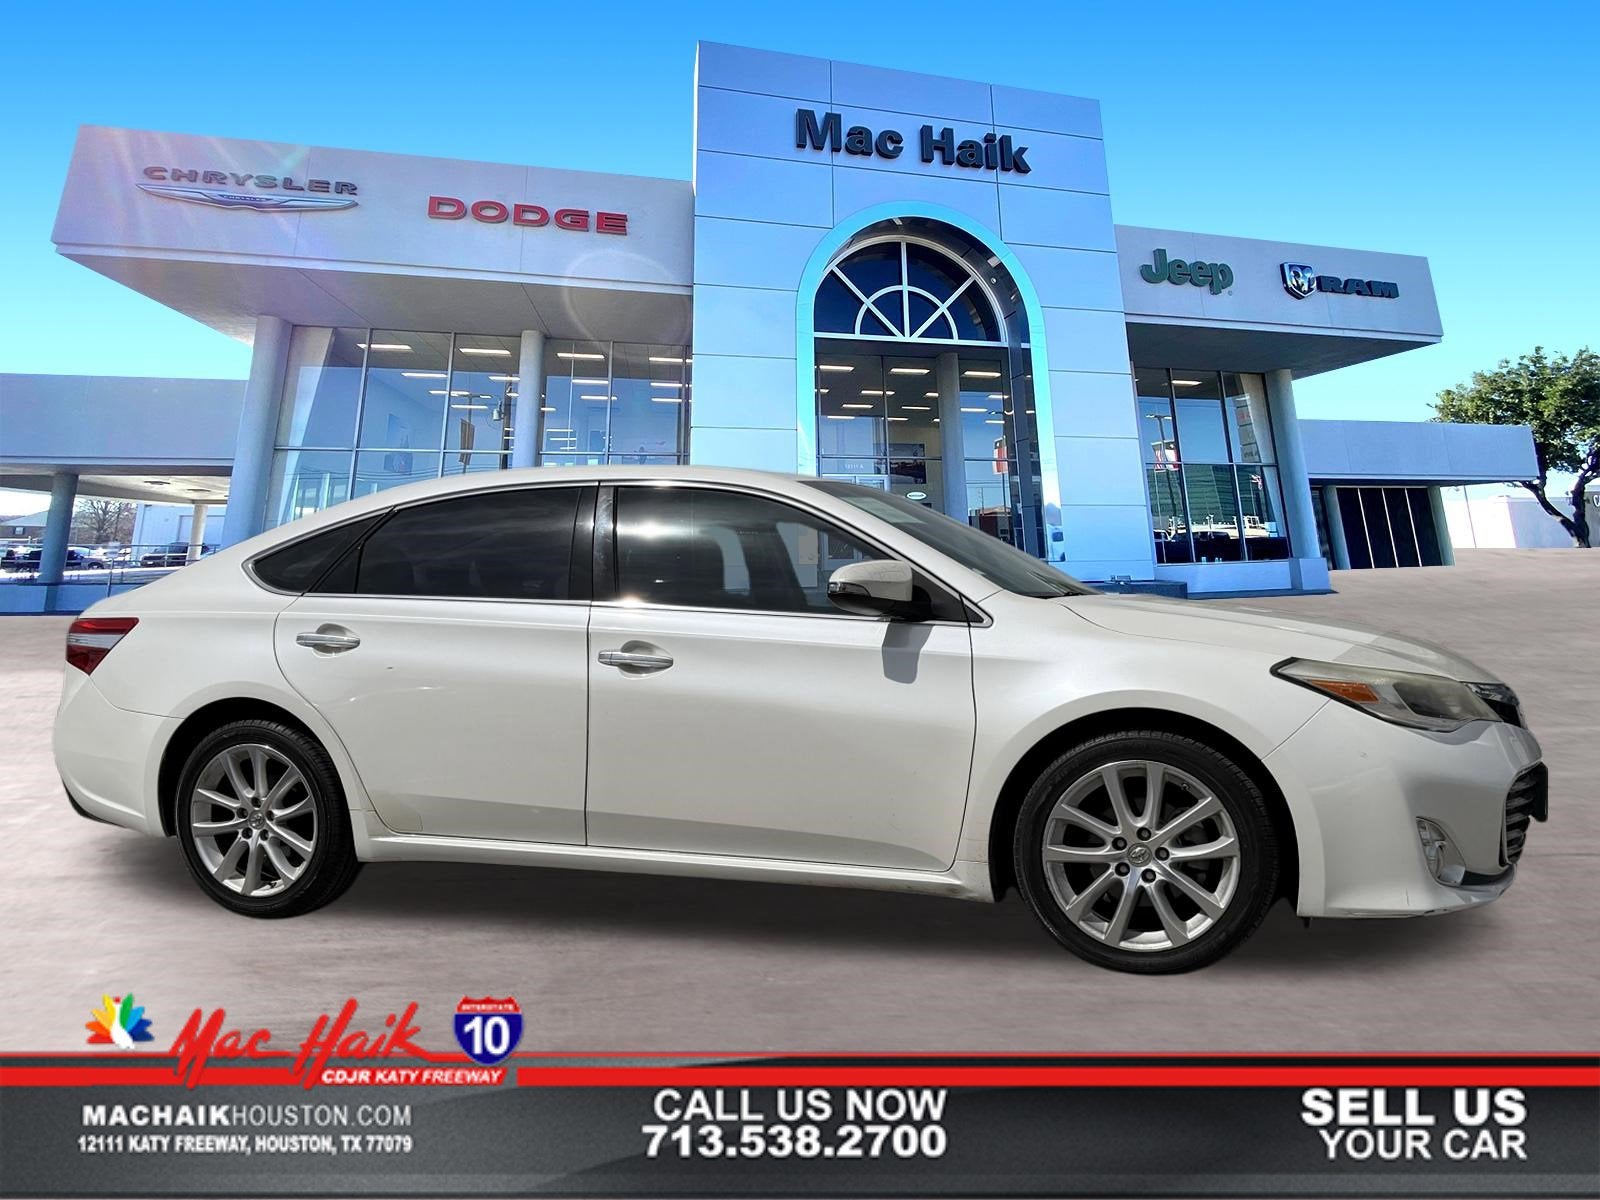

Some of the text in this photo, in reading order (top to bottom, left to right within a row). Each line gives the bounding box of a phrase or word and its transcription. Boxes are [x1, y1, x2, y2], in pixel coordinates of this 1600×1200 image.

[795, 108, 1032, 174] Mac Haik
[143, 166, 358, 195] CHRYSLER
[427, 195, 628, 236] DODGE
[1139, 248, 1234, 295] Jeep
[1316, 275, 1400, 299] RAM
